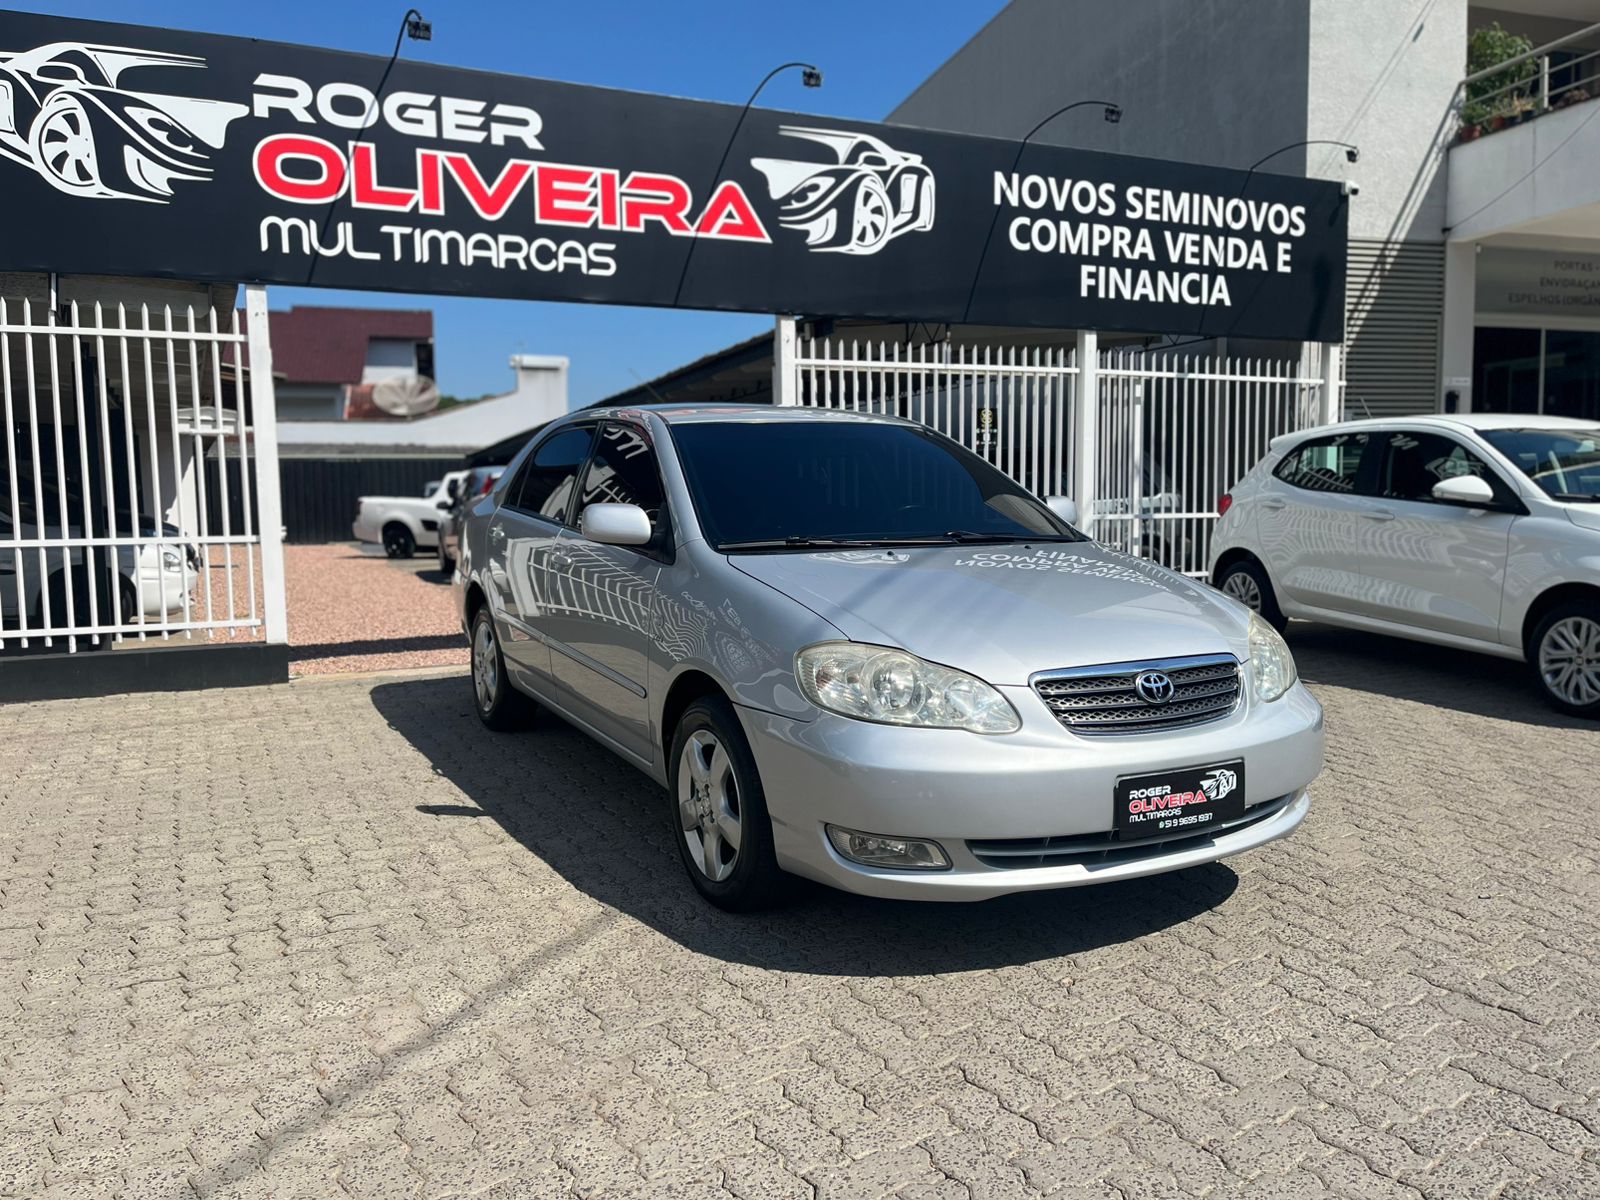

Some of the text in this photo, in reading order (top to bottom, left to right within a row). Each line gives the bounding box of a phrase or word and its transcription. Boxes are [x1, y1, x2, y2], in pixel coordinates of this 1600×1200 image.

[252, 72, 545, 150] ROGER
[252, 132, 773, 244] OLIVEIRA
[993, 170, 1306, 237] NOVOS SEMINOVOS
[259, 215, 617, 277] MULTIMARCAS
[1009, 216, 1292, 273] COMPRA VENDA E
[1553, 260, 1592, 272] PORTAS
[1080, 264, 1232, 306] FINANCIA
[1129, 785, 1171, 799] ROGER
[1129, 790, 1207, 814] OLIVEIRA
[1129, 808, 1182, 823] MULTIMARCAS
